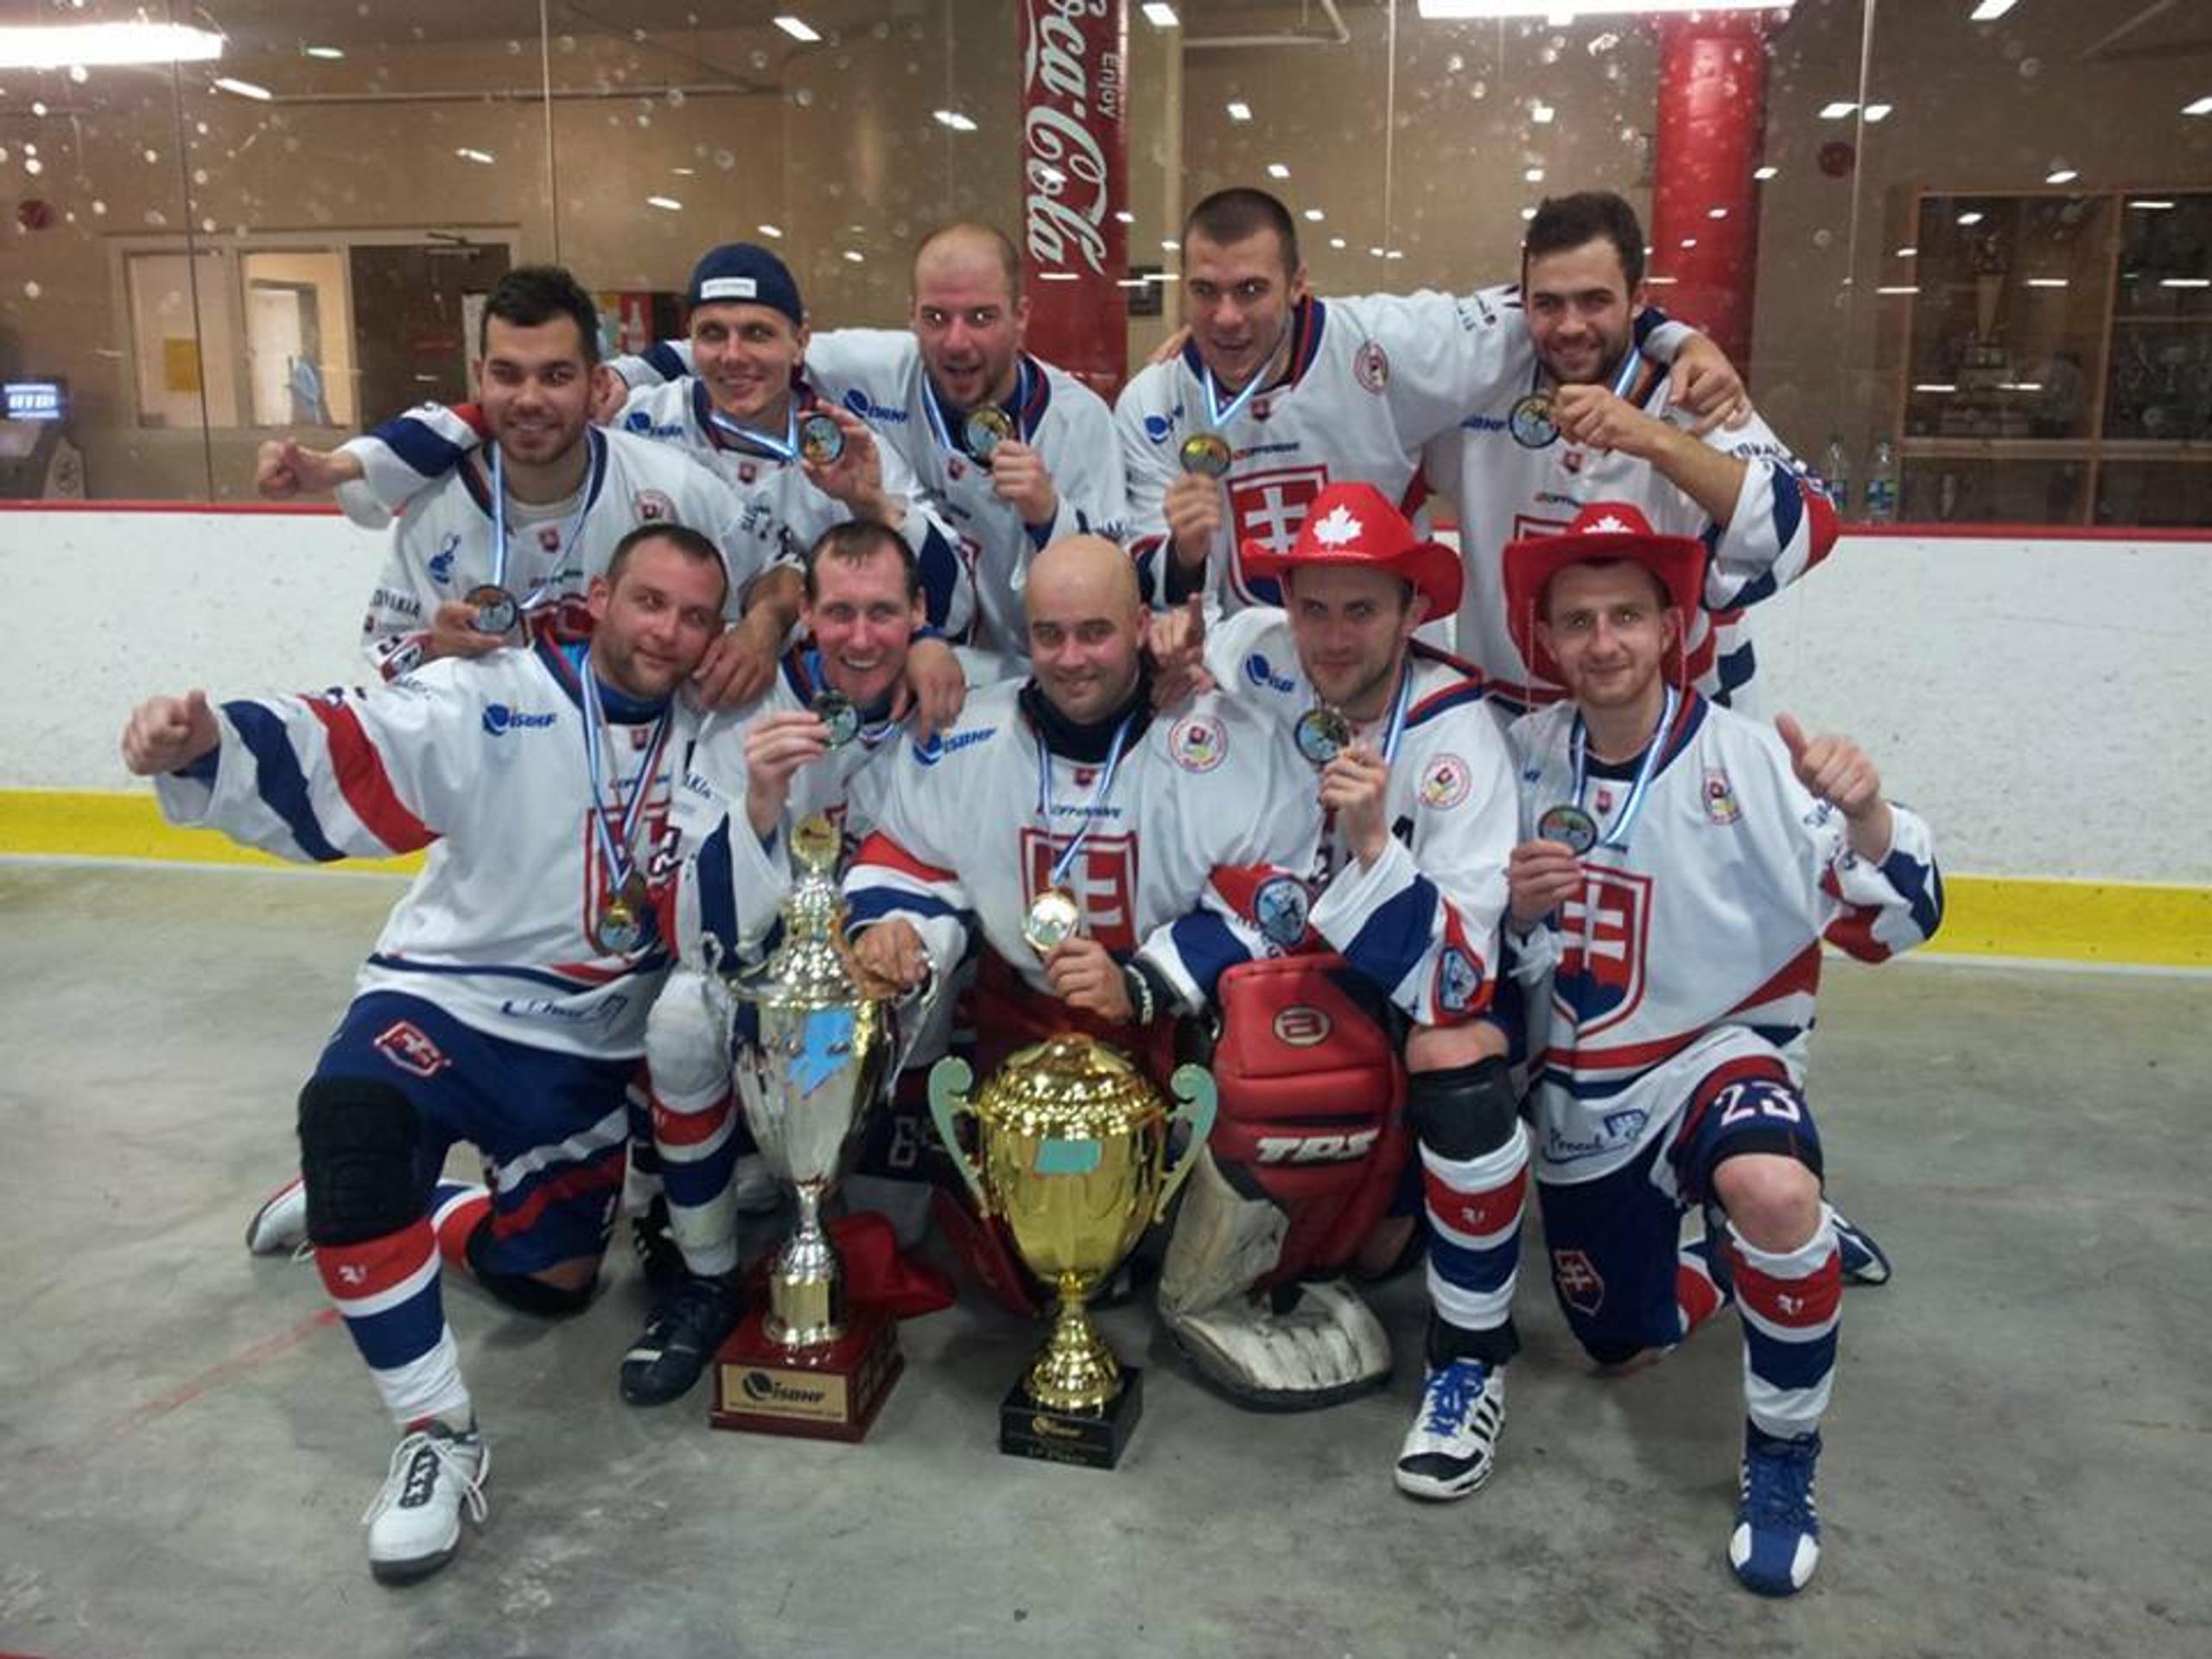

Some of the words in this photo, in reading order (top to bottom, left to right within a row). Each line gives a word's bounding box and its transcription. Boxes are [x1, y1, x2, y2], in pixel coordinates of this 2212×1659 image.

[1096, 52, 1119, 118] Enjoy
[1026, 0, 1107, 276] oca-Cola
[1713, 1080, 1801, 1127] 23
